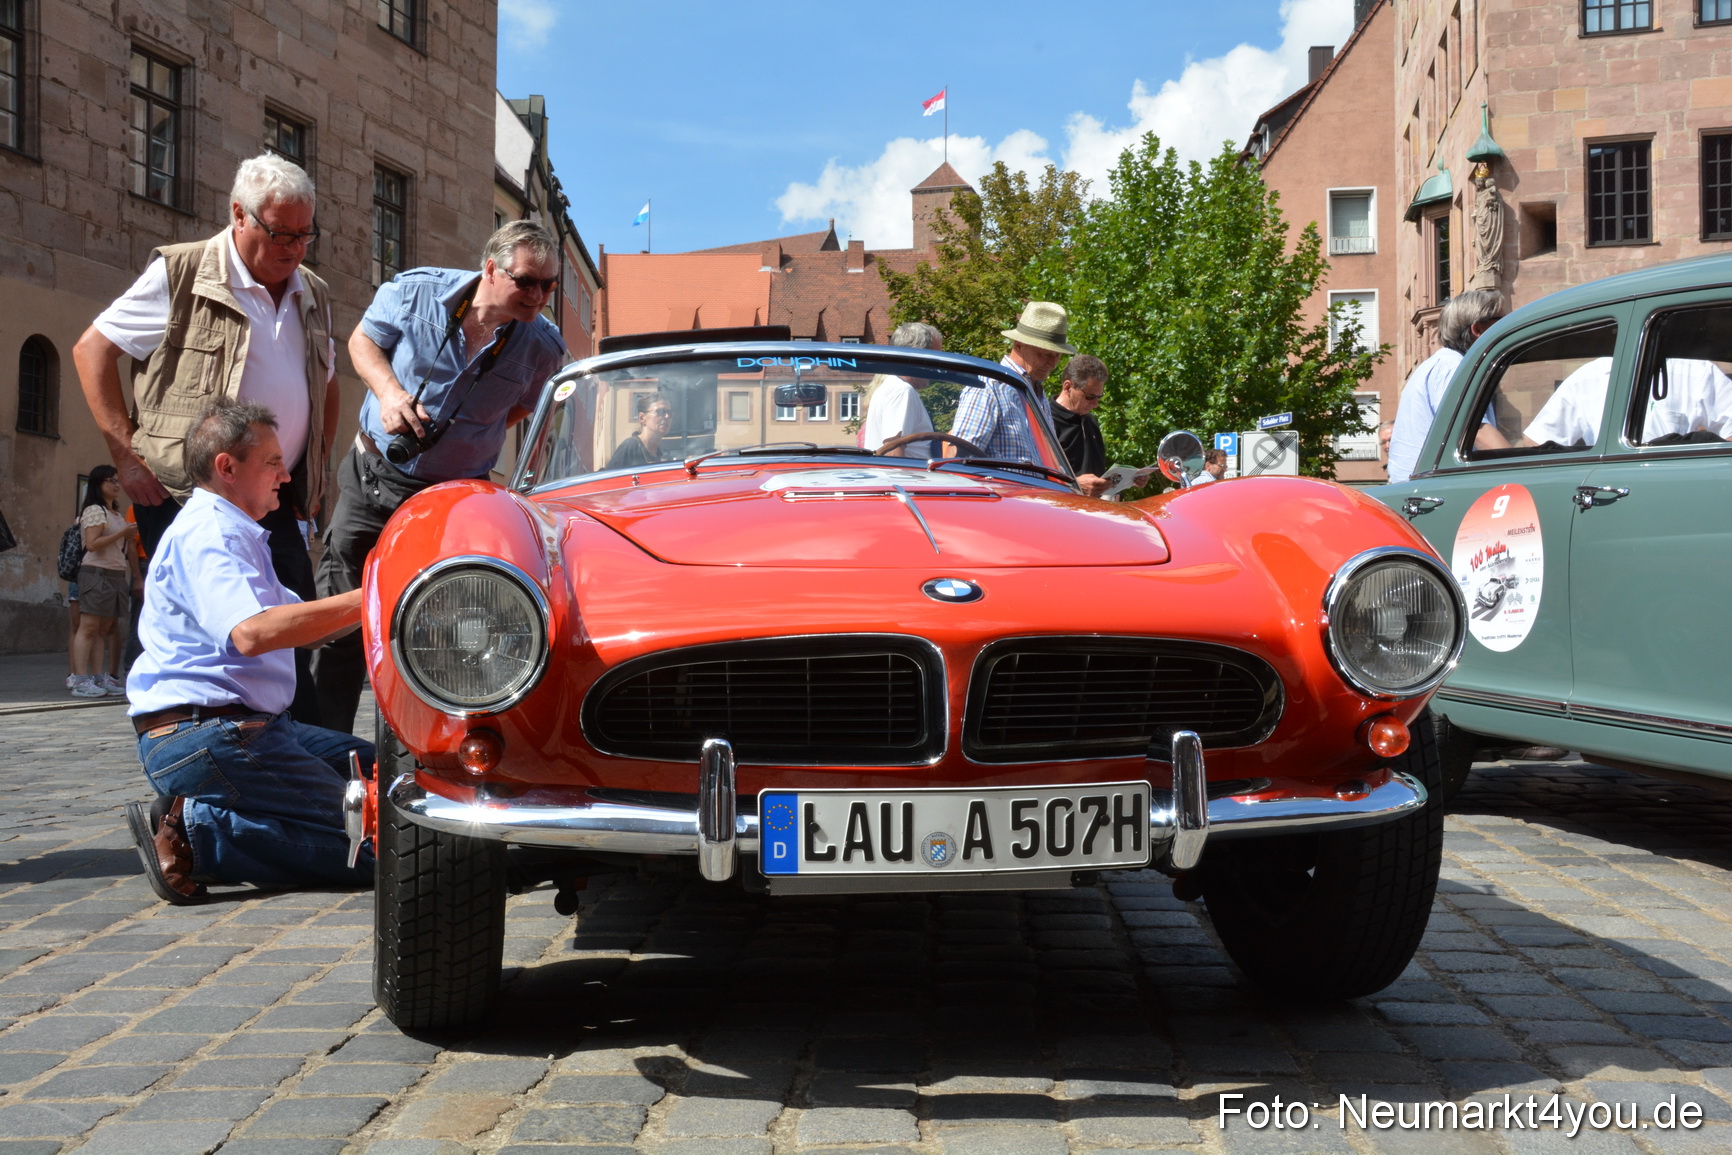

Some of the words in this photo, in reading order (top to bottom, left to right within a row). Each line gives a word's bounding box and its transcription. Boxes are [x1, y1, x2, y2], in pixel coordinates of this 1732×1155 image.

[1491, 494, 1510, 518] 9
[1470, 549, 1483, 572] 100
[802, 800, 914, 863] LAU
[960, 799, 996, 861] A
[773, 842, 787, 859] D
